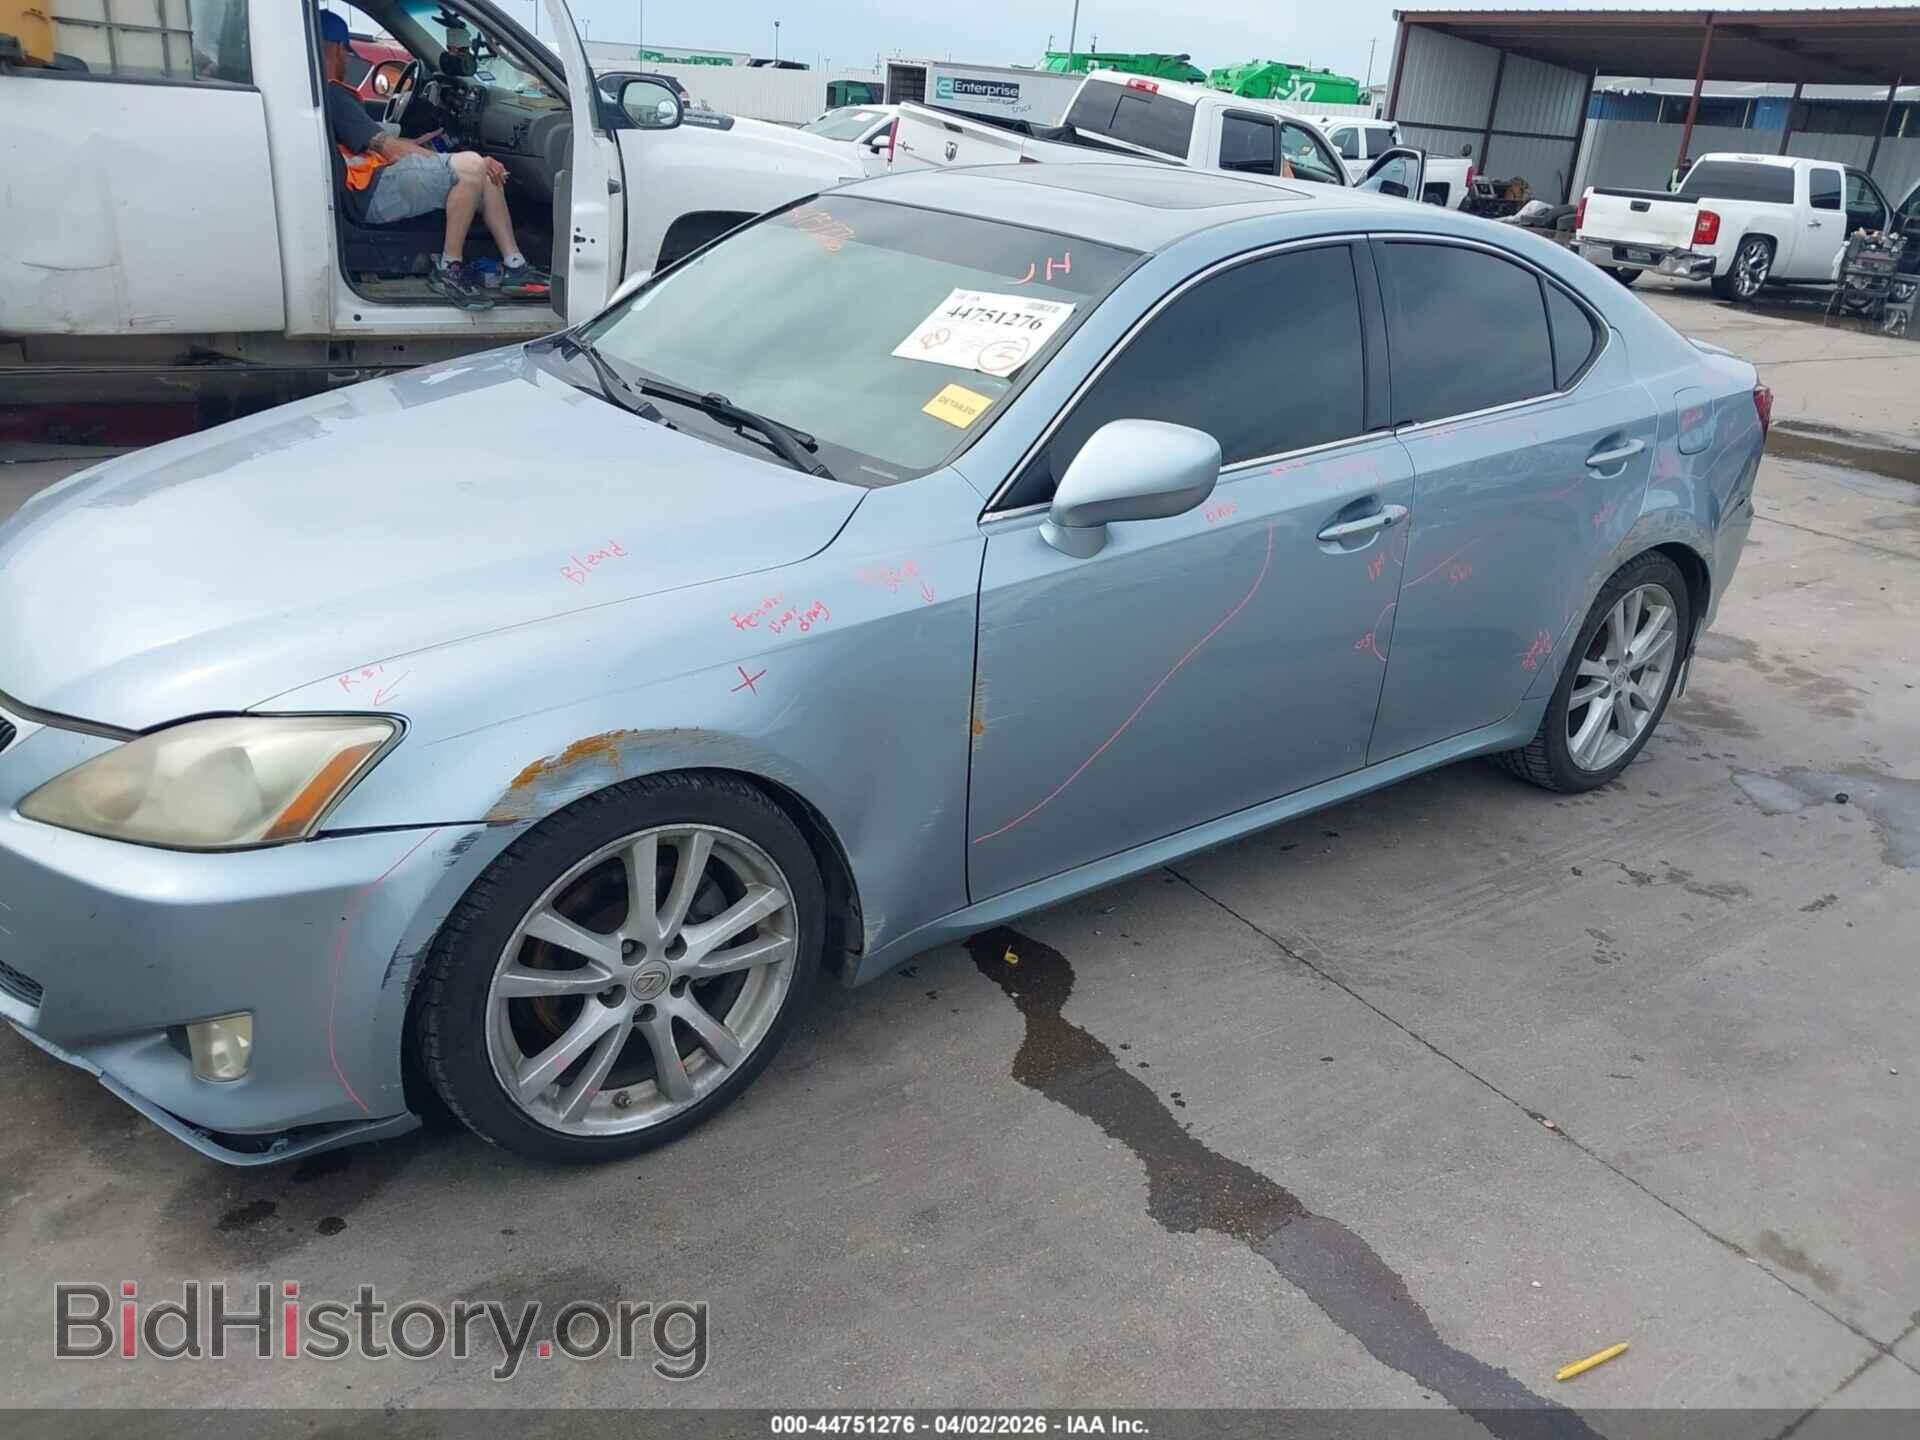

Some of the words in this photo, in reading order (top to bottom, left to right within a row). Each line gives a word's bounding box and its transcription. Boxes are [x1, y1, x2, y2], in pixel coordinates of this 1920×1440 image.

[954, 80, 1018, 97] Enterprise
[946, 305, 1043, 330] 44751276
[559, 539, 628, 585] Blend
